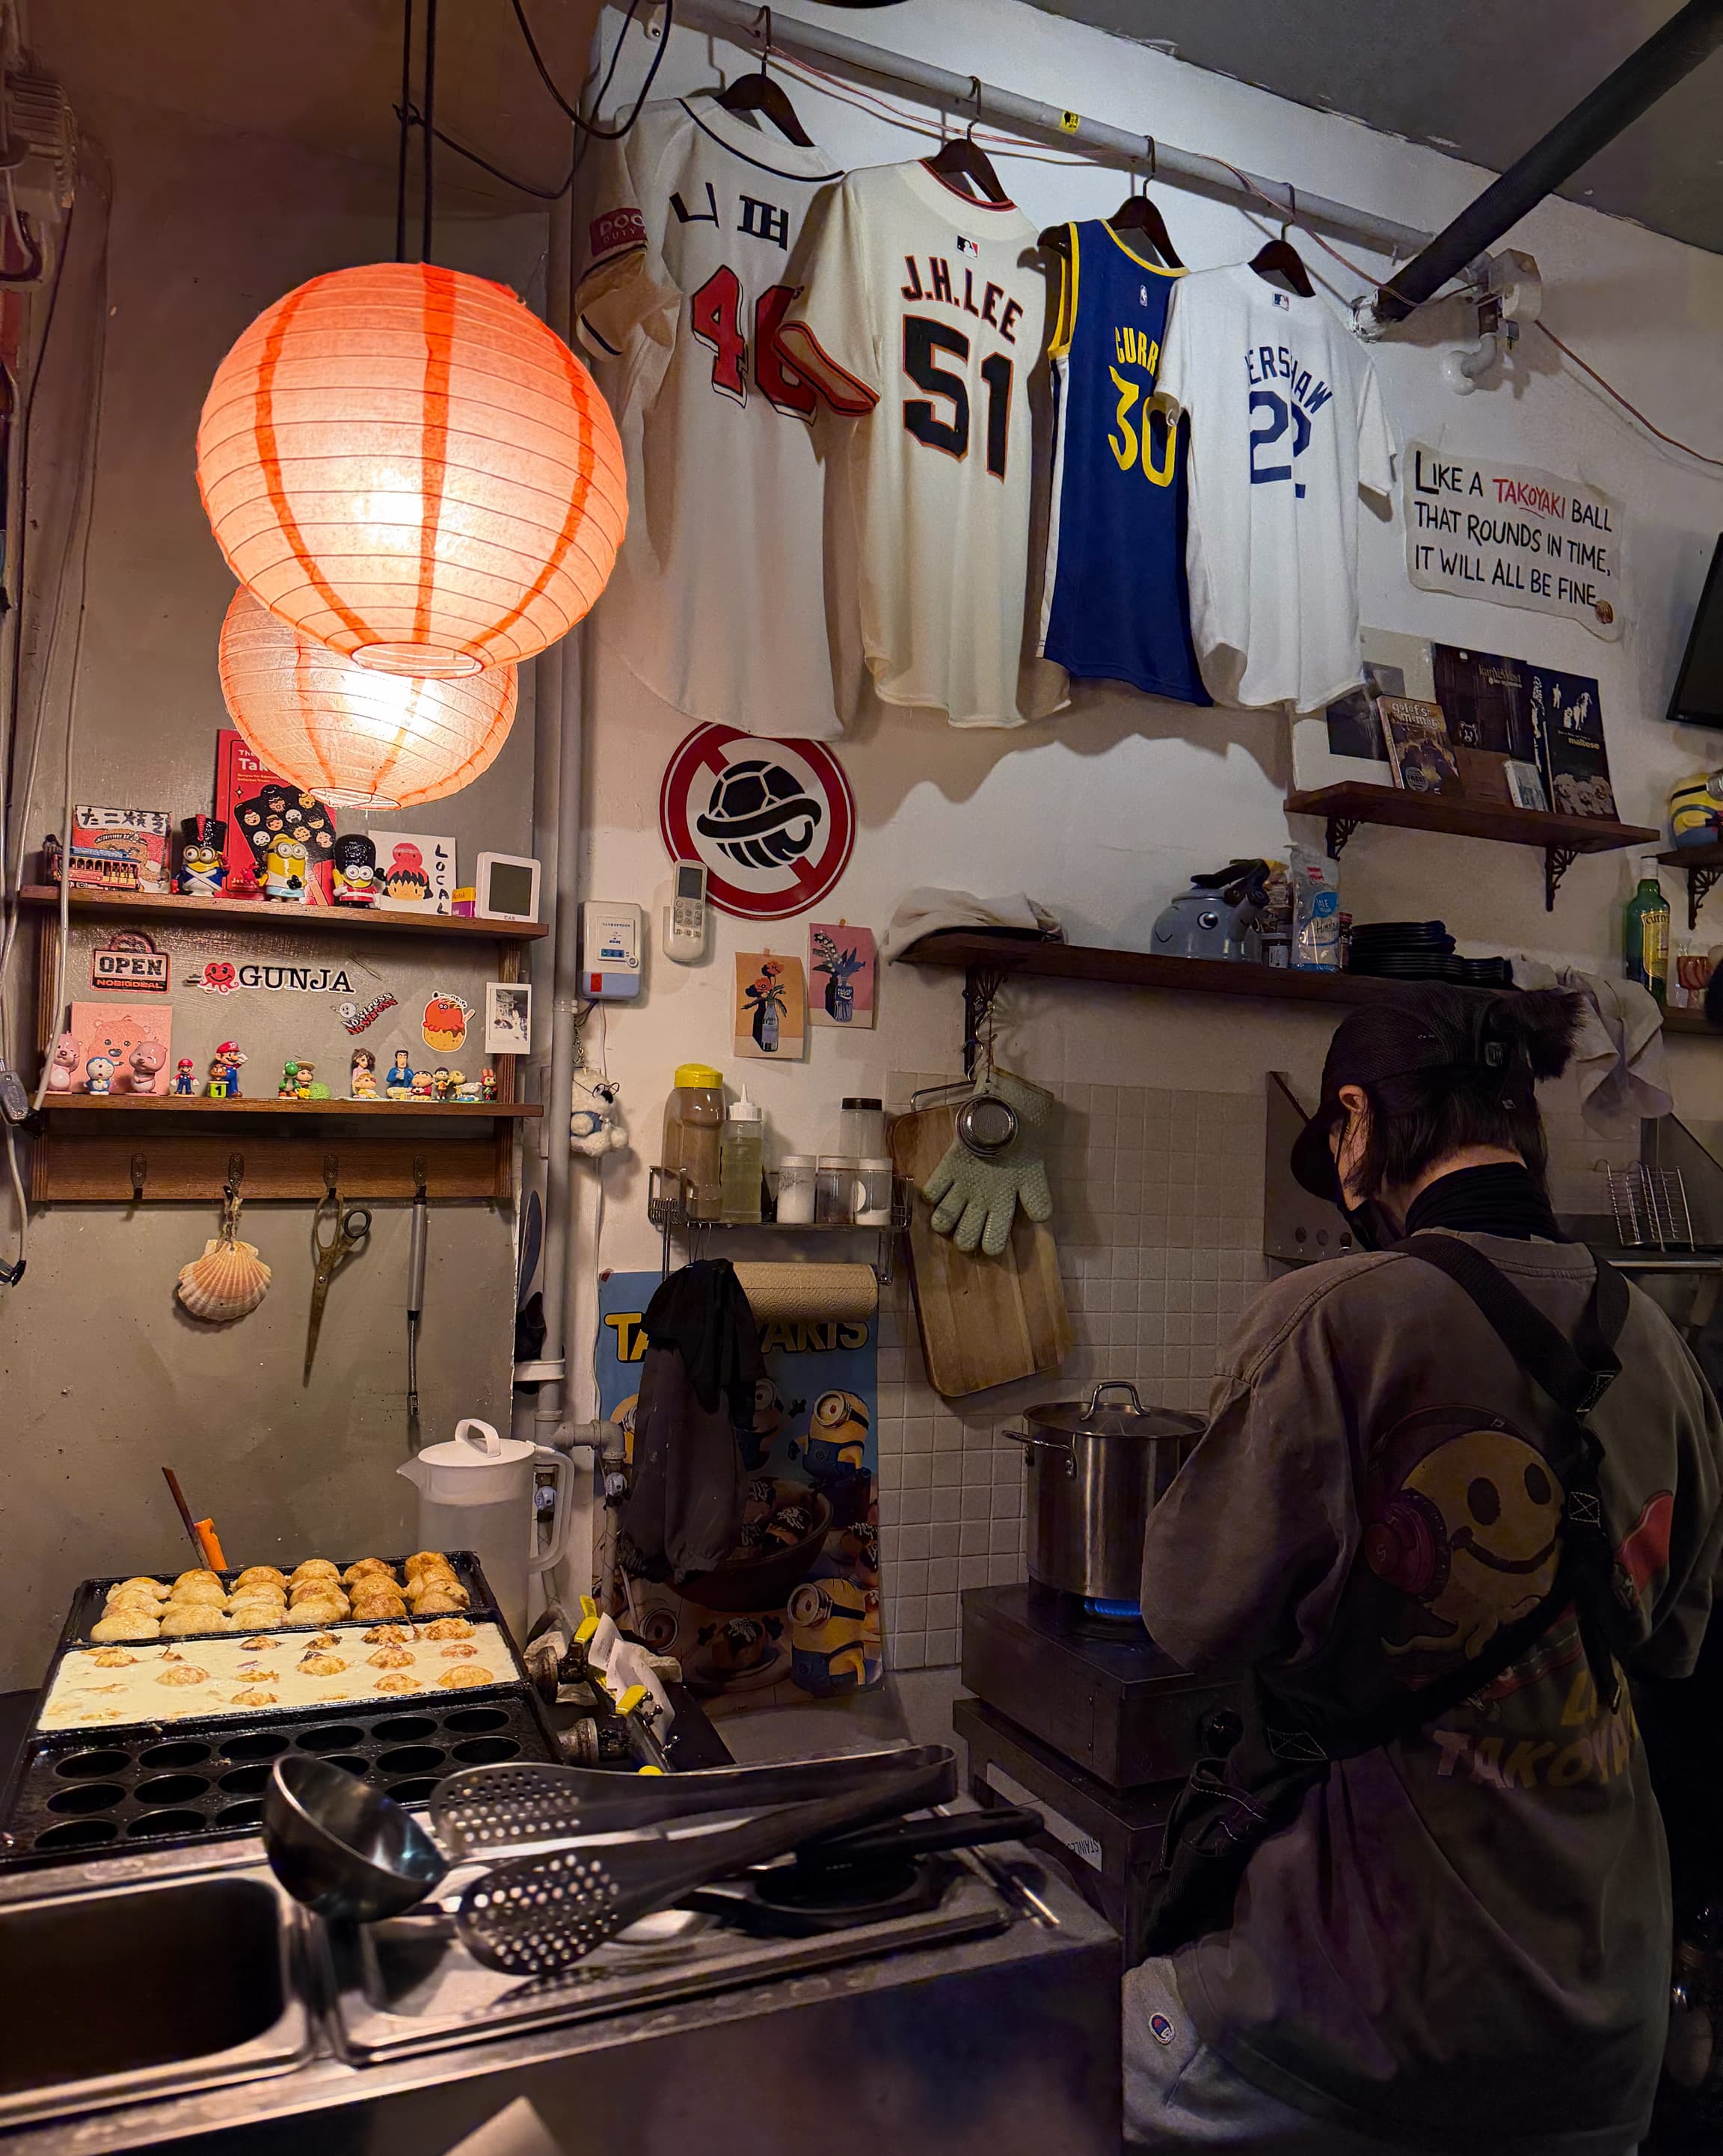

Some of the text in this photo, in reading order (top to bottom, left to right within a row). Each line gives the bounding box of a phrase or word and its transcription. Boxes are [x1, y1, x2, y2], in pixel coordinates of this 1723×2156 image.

[900, 255, 1024, 345] J.H.LEE
[1114, 326, 1159, 376] CURR
[903, 313, 1014, 485] 51
[1108, 366, 1176, 487] 30
[1415, 450, 1612, 532] LIKE A TAKOYAKI BALL
[1414, 501, 1611, 577] THAT ROUNDS IN TIME,
[1416, 544, 1435, 570] IT
[1440, 548, 1485, 582] WILL
[1492, 558, 1525, 589] ALL
[1530, 569, 1552, 598] BE
[435, 844, 449, 915] LOCAL
[99, 956, 162, 976] OPEN
[239, 965, 355, 994] GUNJA
[215, 1085, 222, 1096] 1
